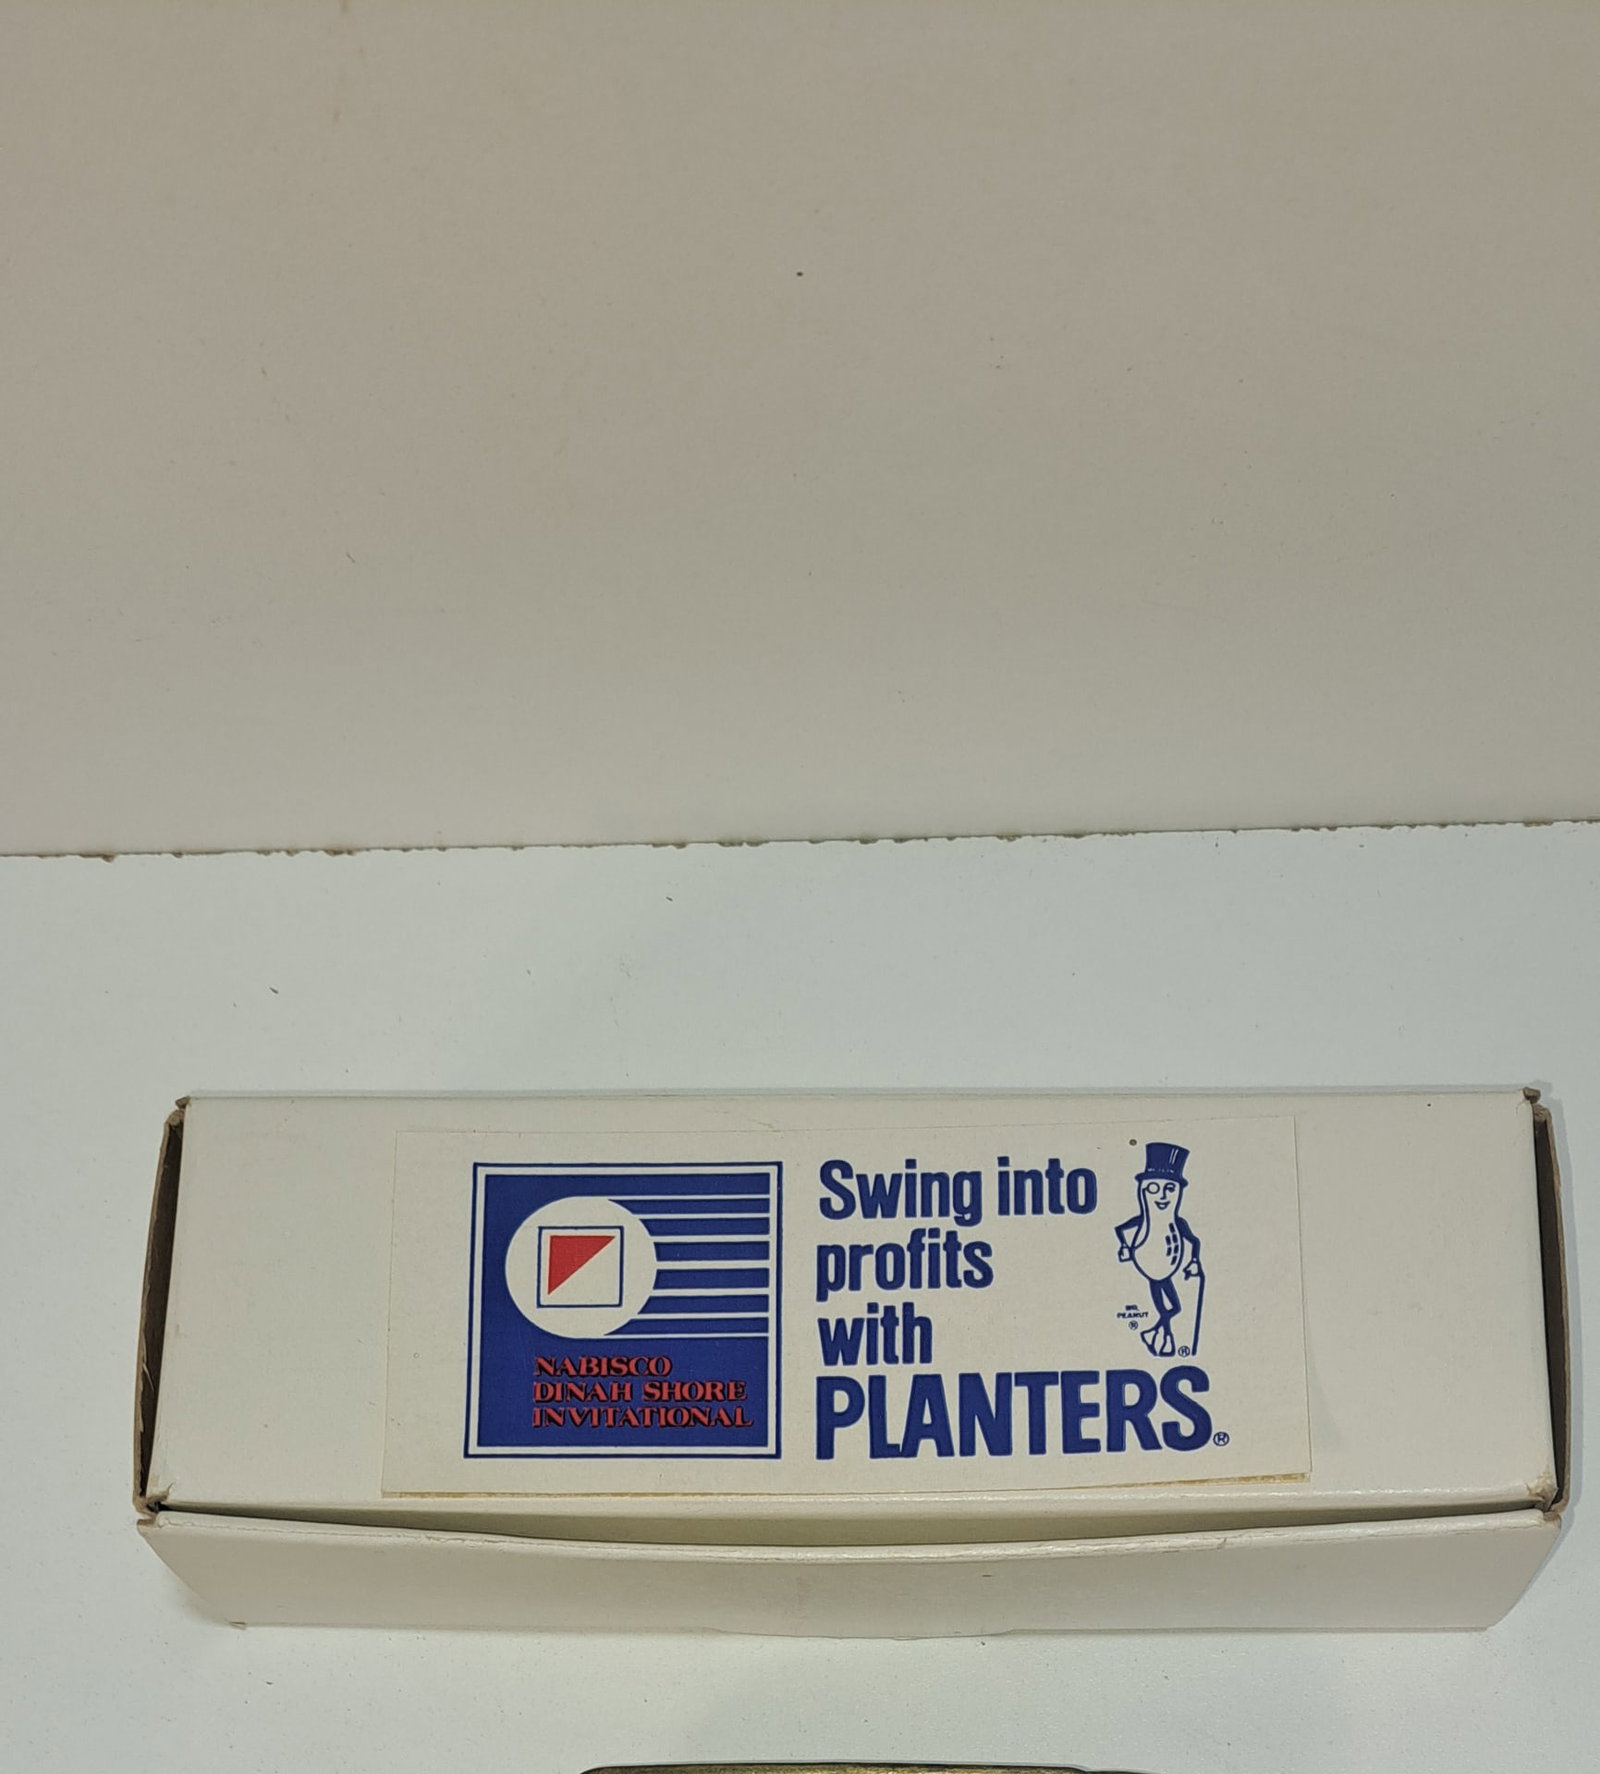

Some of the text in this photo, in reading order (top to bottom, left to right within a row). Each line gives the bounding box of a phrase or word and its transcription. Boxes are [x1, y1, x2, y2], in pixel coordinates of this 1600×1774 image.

[818, 1156, 1098, 1228] Swing into
[816, 1227, 995, 1302] profits
[817, 1301, 933, 1367] with
[534, 1355, 673, 1377] NABISCO
[533, 1380, 748, 1403] DINAH SHORE
[532, 1406, 754, 1428] INVITATIONAL
